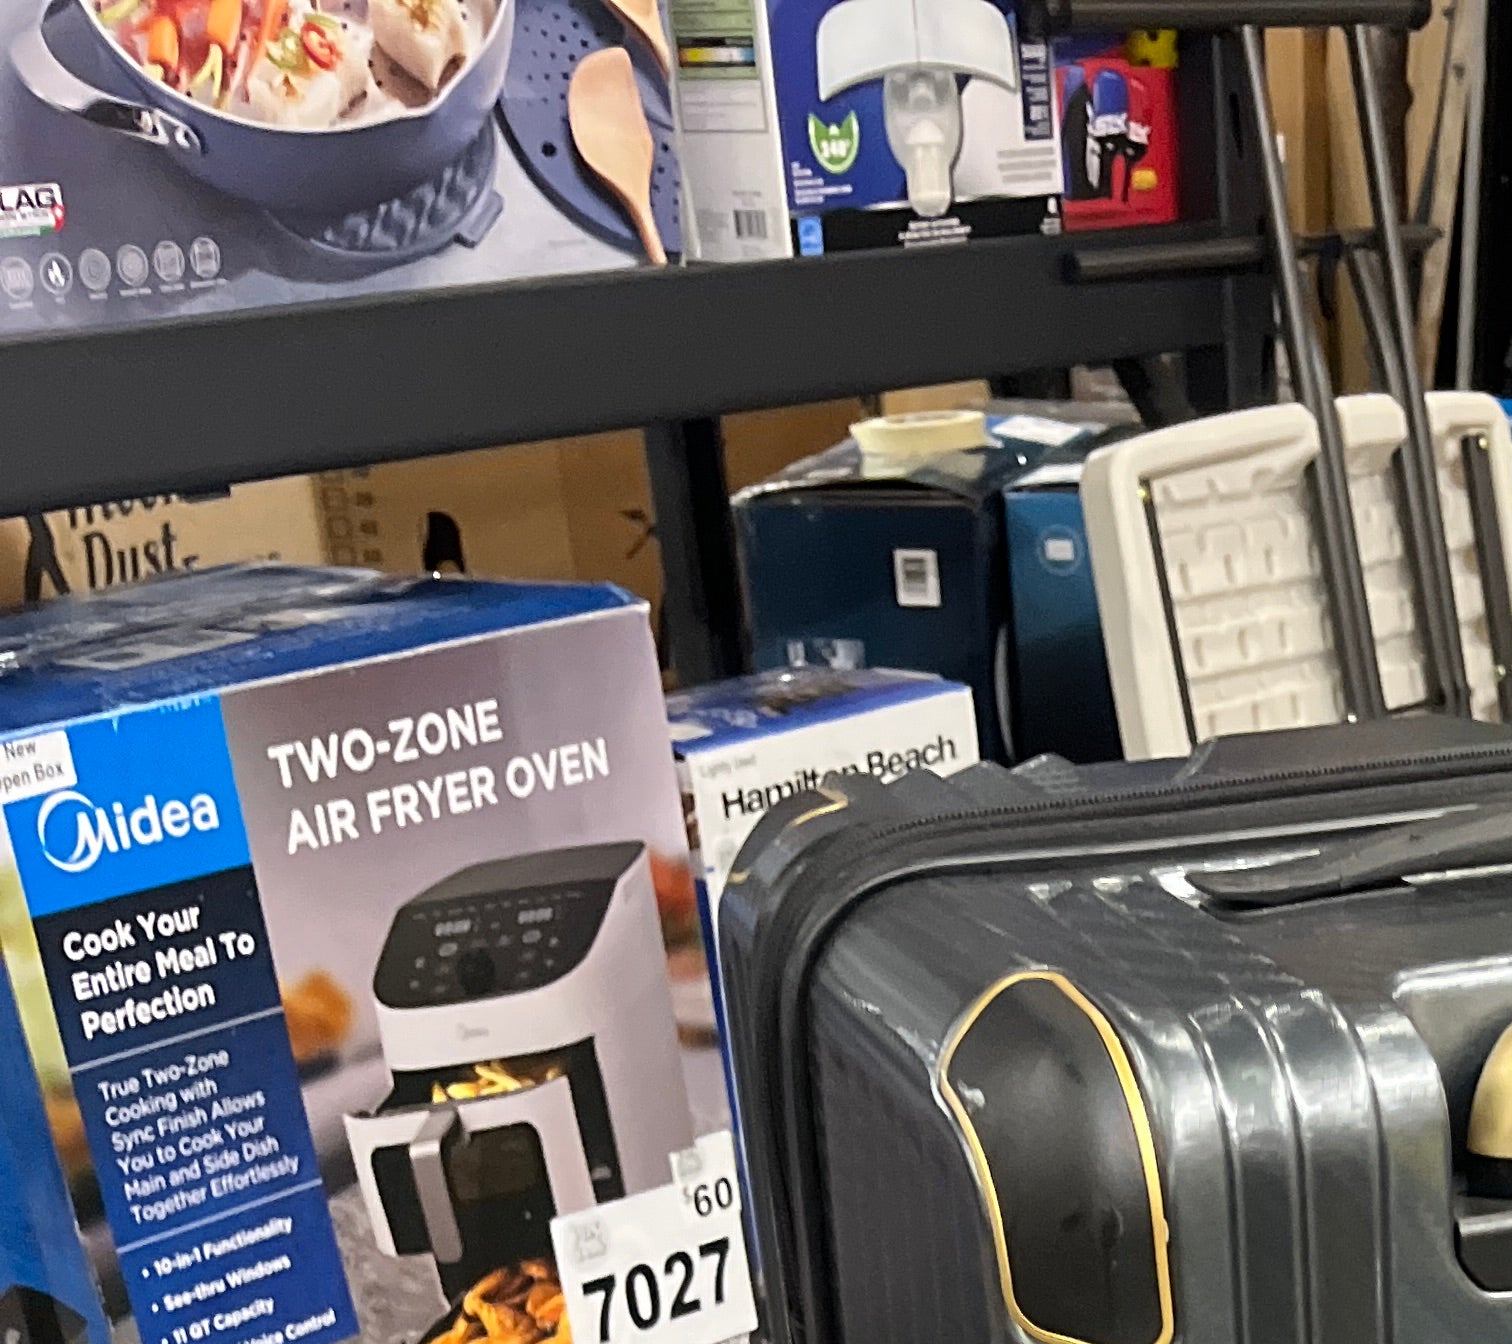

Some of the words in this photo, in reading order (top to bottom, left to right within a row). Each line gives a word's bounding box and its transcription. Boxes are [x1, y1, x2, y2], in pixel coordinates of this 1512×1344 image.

[84, 522, 177, 590] Dust
[4, 740, 37, 761] New
[267, 698, 503, 789] TWO-ZONE
[0, 769, 31, 794] pen
[34, 763, 65, 783] Box
[288, 799, 360, 855] AIR
[367, 766, 499, 835] FRYER
[505, 737, 611, 799] OVEN
[721, 765, 859, 819] Hamilt
[866, 734, 957, 777] Beach
[38, 790, 219, 873] Midea
[63, 919, 136, 961] Cook
[136, 906, 201, 941] Your
[71, 960, 152, 1001] Entire
[155, 936, 218, 979] Meal
[219, 931, 256, 960] To
[80, 983, 216, 1040] Perfection
[98, 1077, 140, 1101] True
[141, 1049, 230, 1088] Two-Zone
[105, 1091, 178, 1128] Cooking
[180, 1078, 218, 1103] with
[111, 1125, 156, 1153] Sync
[156, 1105, 208, 1137] Finish
[211, 1090, 266, 1121] Allows
[116, 1153, 155, 1176] You
[156, 1144, 177, 1164] to
[178, 1128, 225, 1157] Cook
[224, 1115, 265, 1140] Your
[123, 1175, 167, 1201] Main
[169, 1158, 202, 1187] and
[202, 1149, 240, 1175] Side
[241, 1135, 280, 1162] Dish
[130, 1186, 208, 1225] Together
[209, 1155, 299, 1198] Effortlessly
[153, 1247, 202, 1278] 10-in-1
[202, 1216, 293, 1261] Functionality
[162, 1278, 227, 1313] See-thru
[225, 1254, 292, 1289] Windows
[212, 1297, 275, 1331] Capacity
[582, 1236, 730, 1344] 7027
[284, 1307, 337, 1342] Control
